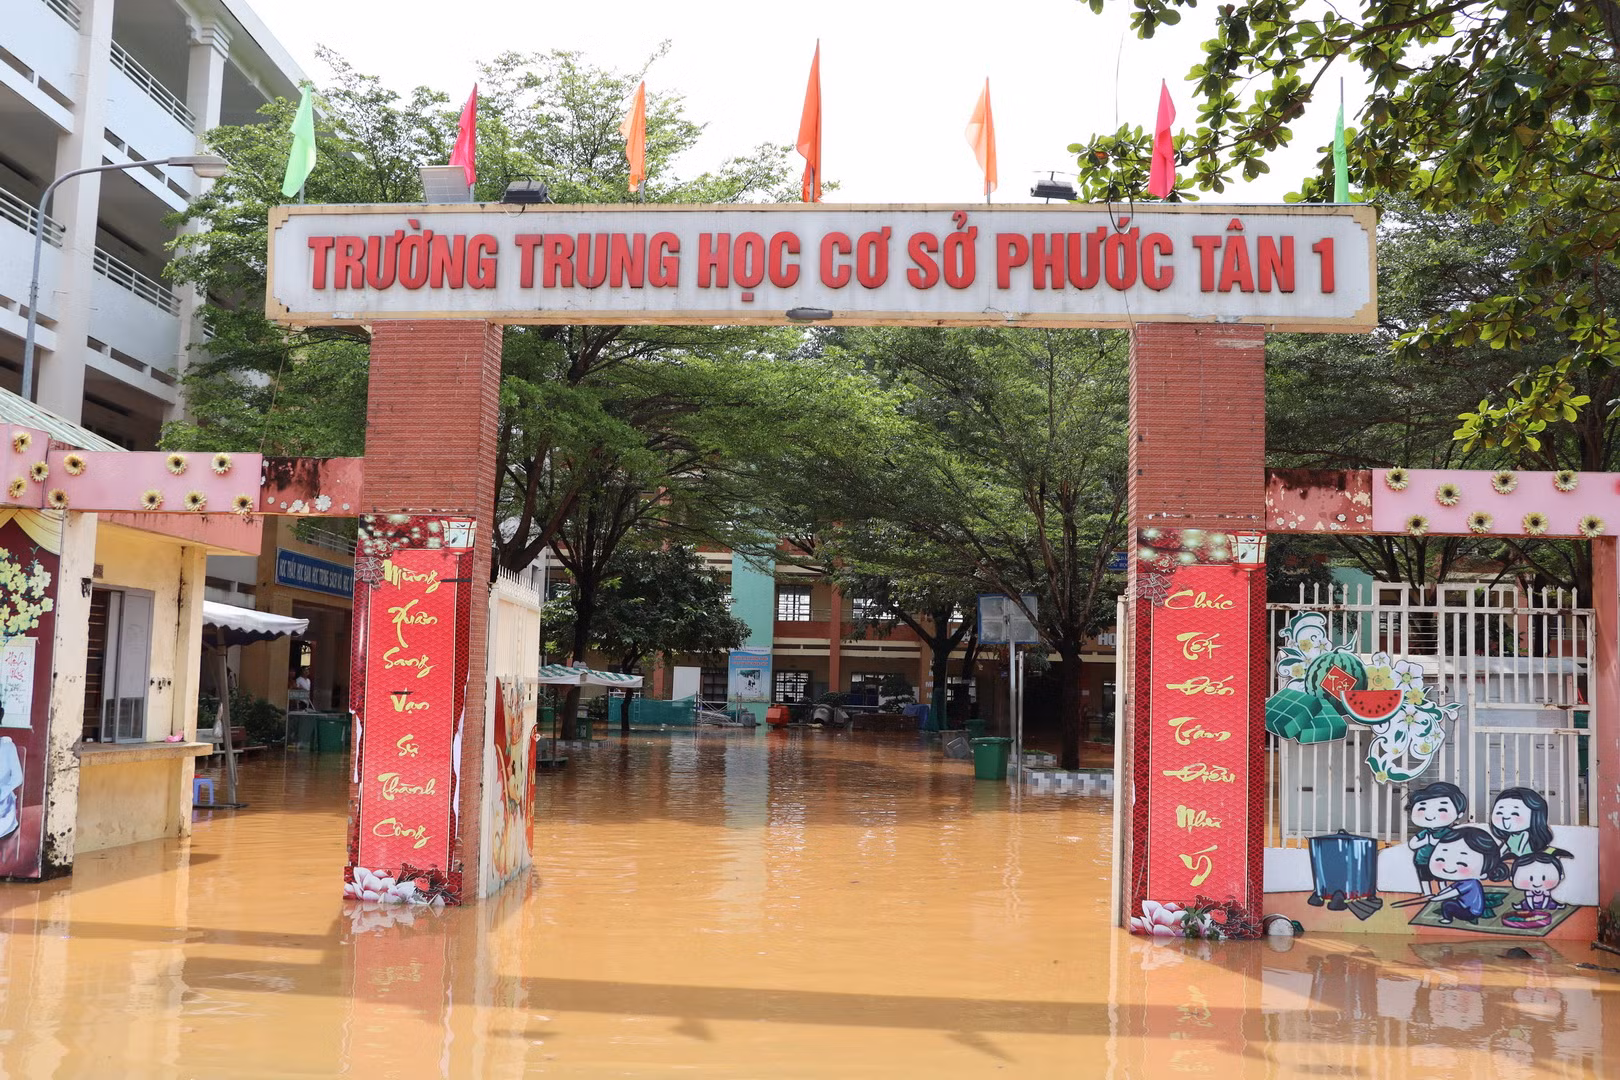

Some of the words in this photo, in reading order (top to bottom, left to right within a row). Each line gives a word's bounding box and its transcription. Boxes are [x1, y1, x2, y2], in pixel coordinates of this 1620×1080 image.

[307, 219, 498, 289] TRƯỜNG
[514, 231, 680, 289] TRUNG
[697, 231, 800, 301] HỌC
[819, 225, 892, 290] CƠ
[907, 210, 978, 290] SỞ
[997, 217, 1175, 291] PHƯỚC
[1193, 218, 1295, 293] TÂN
[1312, 237, 1335, 293] 1
[382, 559, 441, 593] Mừng
[1164, 589, 1237, 610] Chúc
[388, 599, 438, 648] Xuân
[1176, 631, 1224, 661] Tết
[383, 646, 438, 679] Sang
[1166, 675, 1235, 696] Đến
[390, 687, 430, 714] Vạn
[396, 733, 419, 757] Sự
[377, 772, 436, 801] Thành
[1162, 762, 1236, 784] Điều
[372, 817, 432, 849] Công
